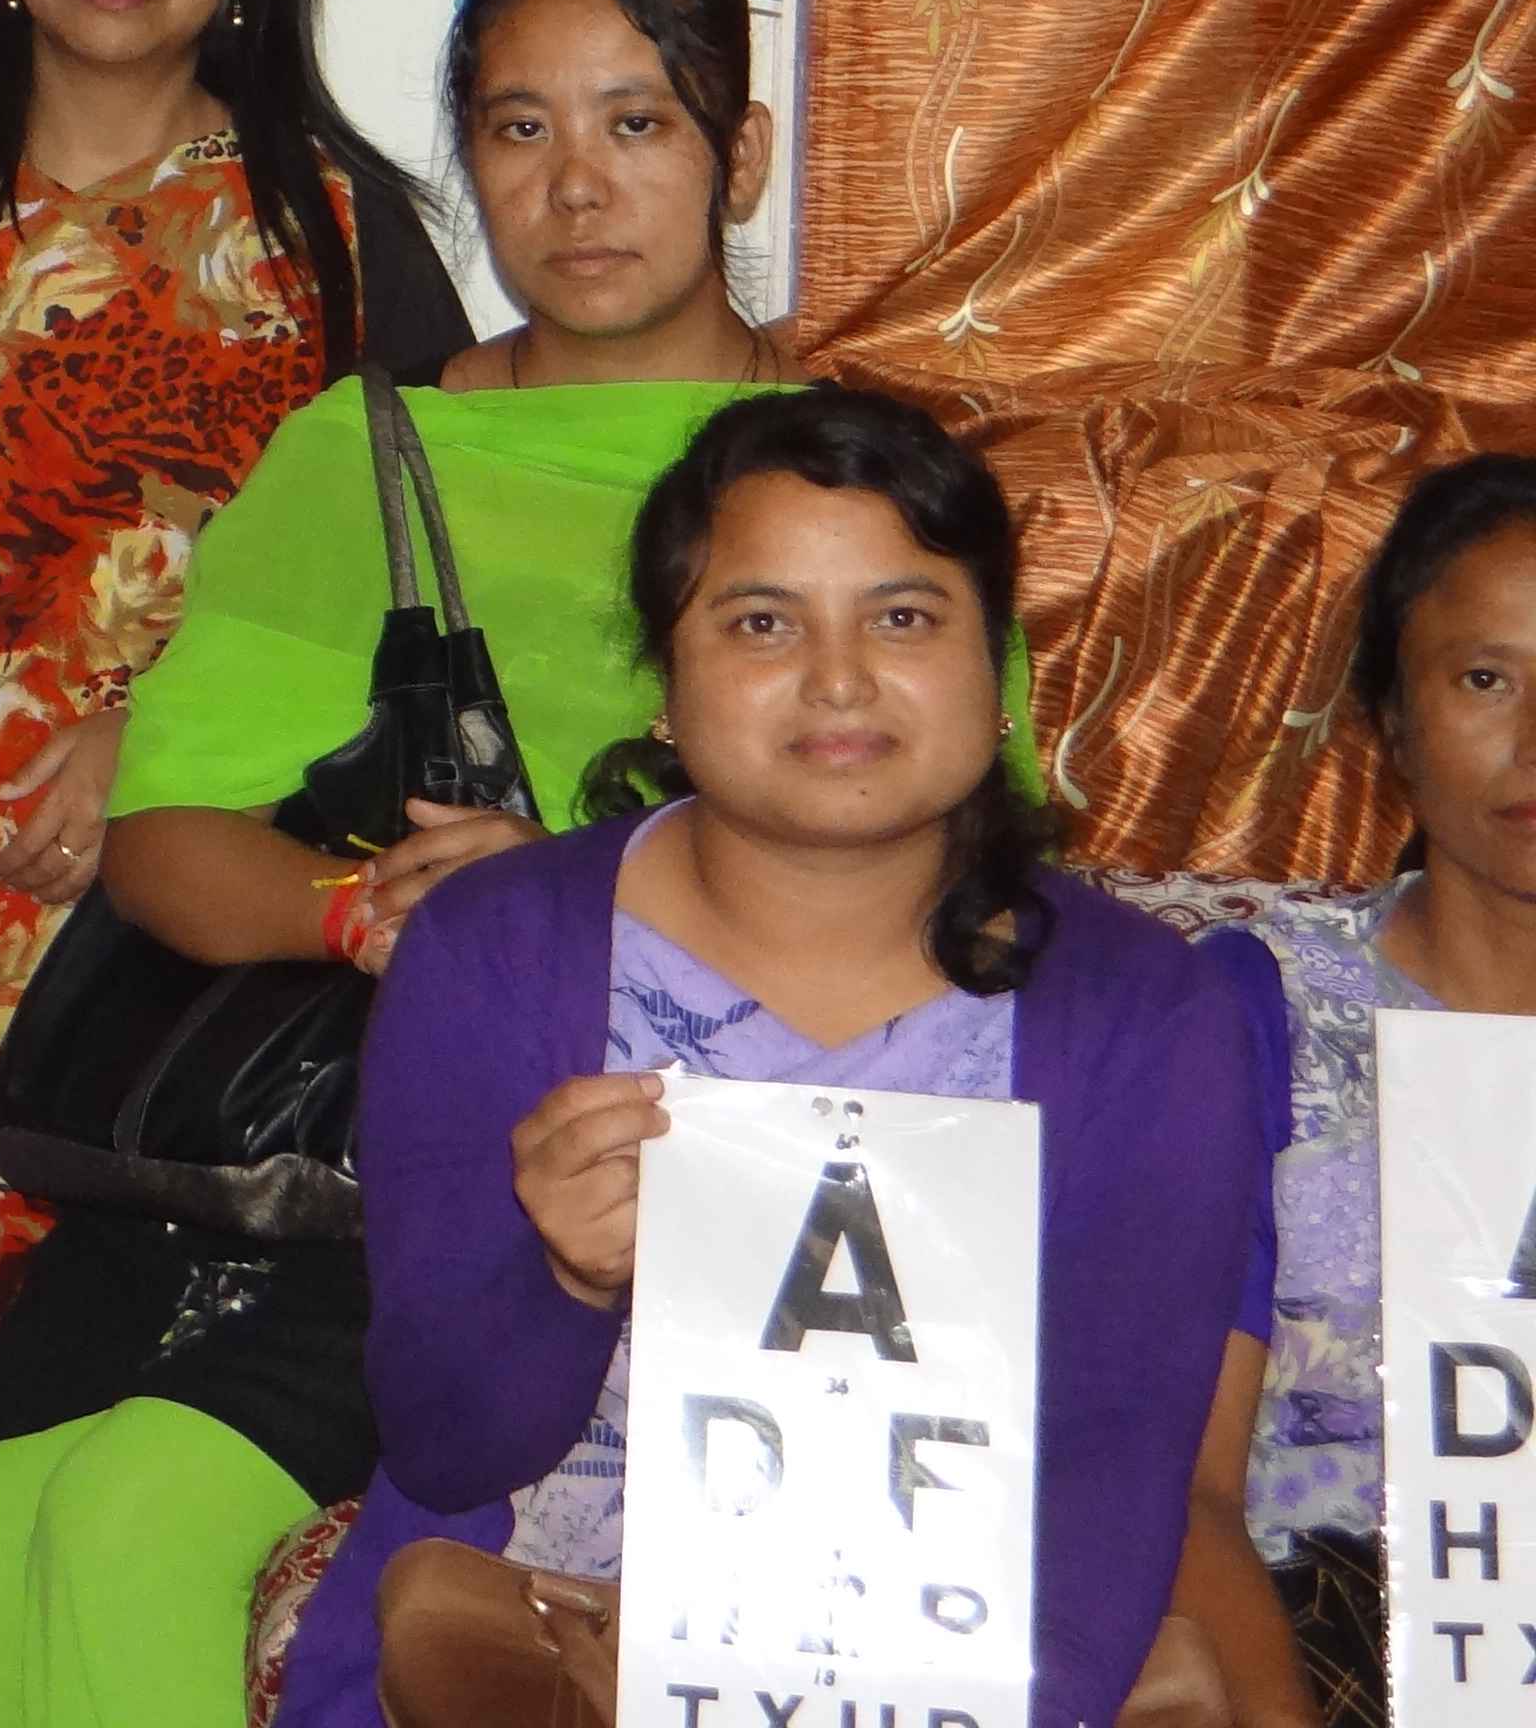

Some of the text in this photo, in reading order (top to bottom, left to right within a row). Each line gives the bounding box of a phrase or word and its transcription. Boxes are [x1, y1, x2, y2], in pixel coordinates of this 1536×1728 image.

[758, 1160, 919, 1364] A
[825, 1376, 850, 1396] 36
[1428, 1341, 1534, 1458] D
[682, 1392, 991, 1534] D F
[1429, 1500, 1500, 1581] H
[813, 1667, 837, 1687] 18
[1432, 1621, 1484, 1684] T
